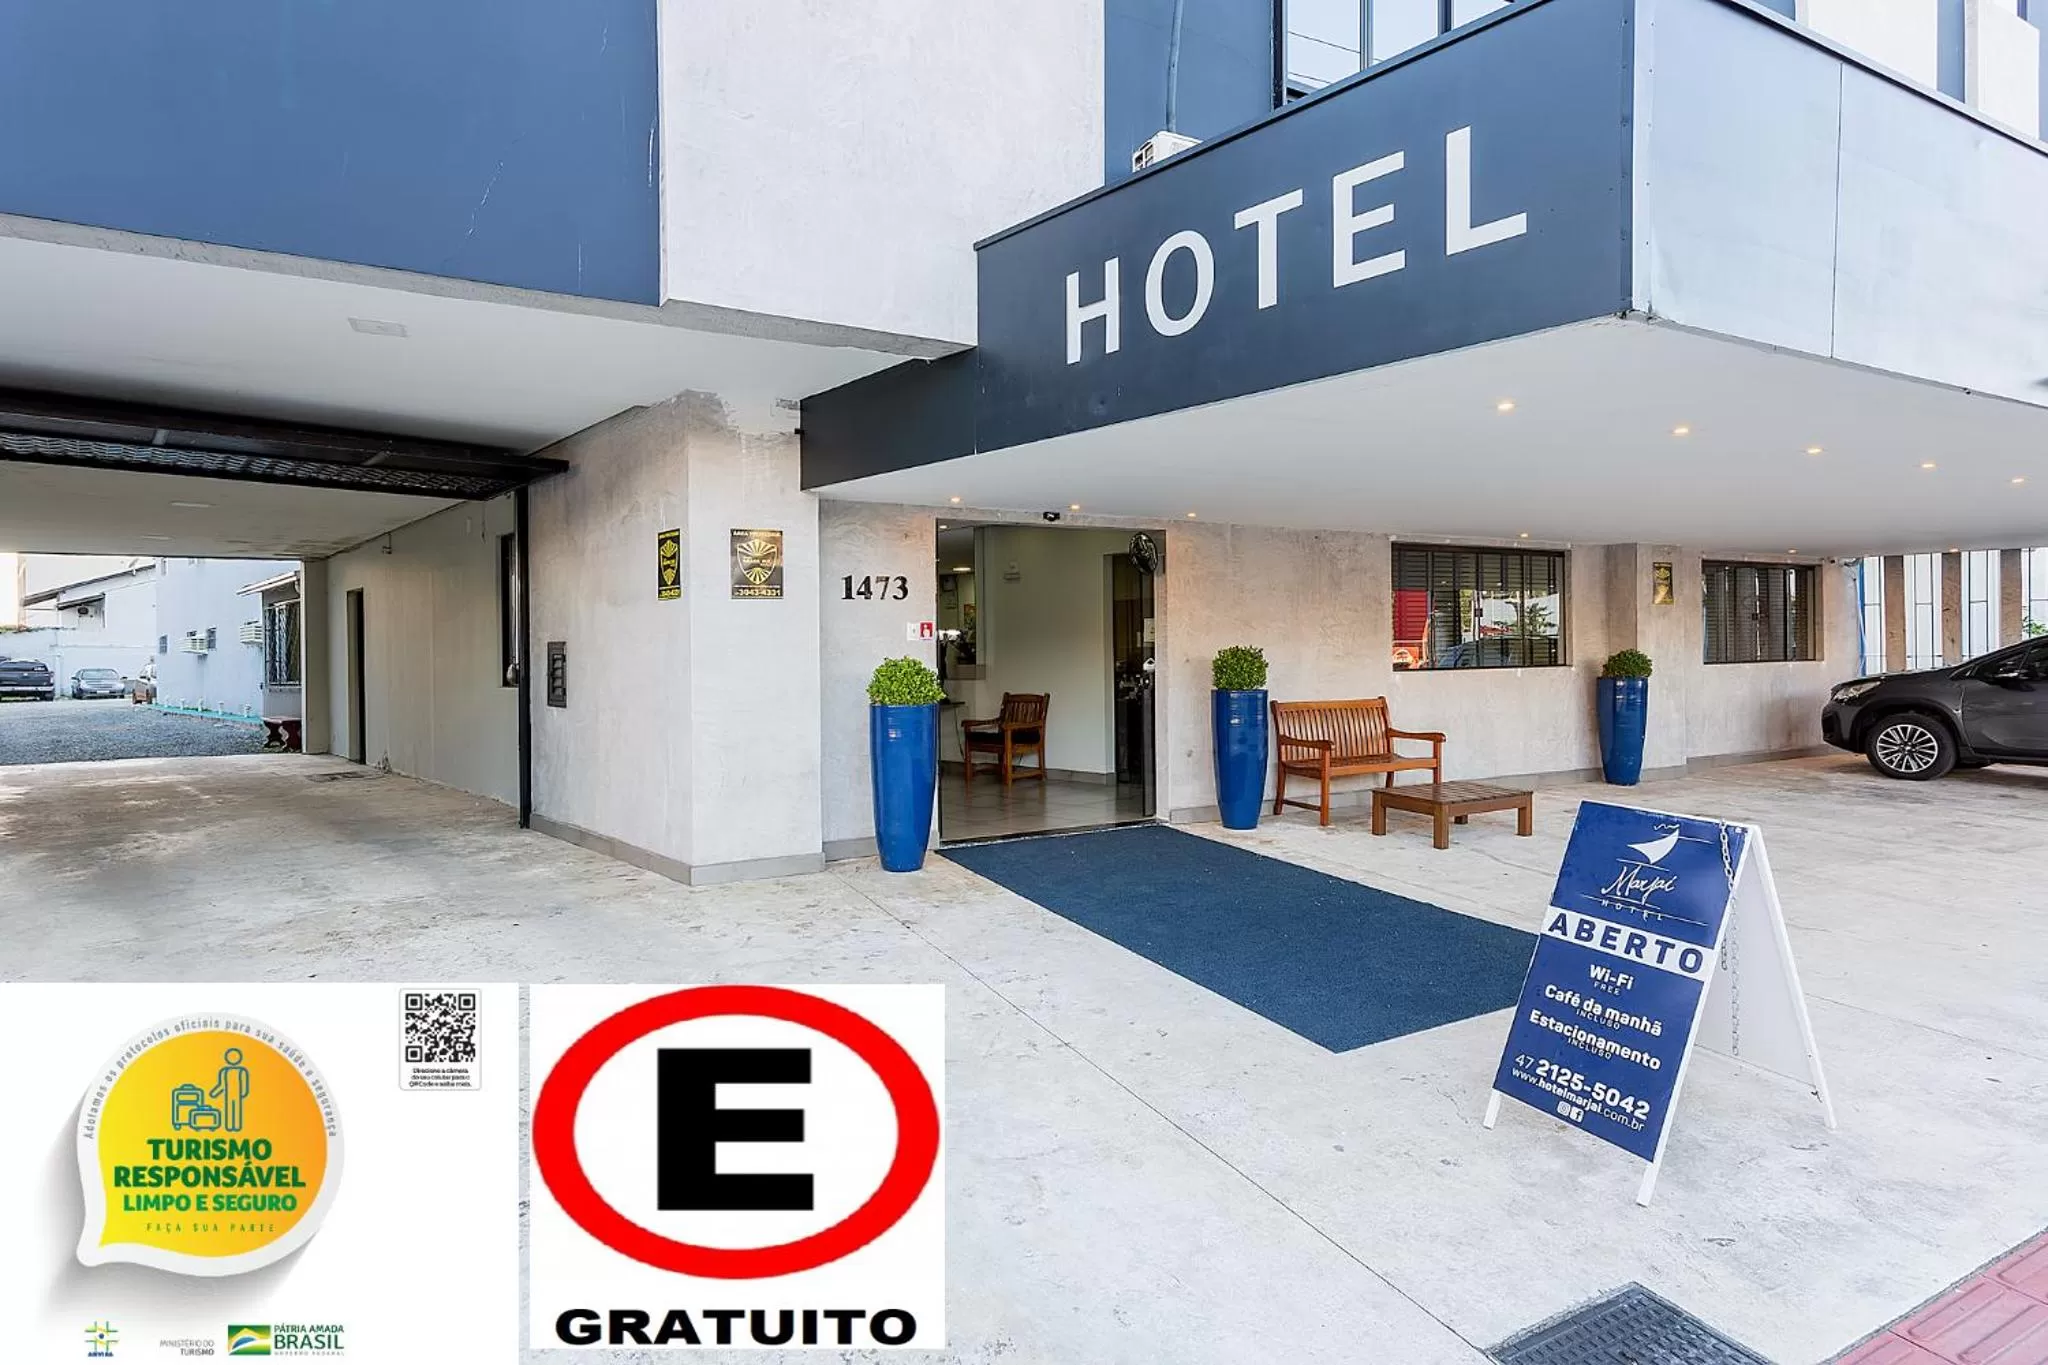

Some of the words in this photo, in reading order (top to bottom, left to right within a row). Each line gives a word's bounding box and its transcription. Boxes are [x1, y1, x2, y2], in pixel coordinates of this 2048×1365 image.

[1066, 125, 1527, 365] HOTEL
[841, 575, 909, 600] 1473
[1601, 900, 1663, 922] HOTEL
[1548, 913, 1703, 974] ABERTO
[1590, 964, 1634, 990] Wi-Fi
[1594, 981, 1621, 996] FREE
[1545, 984, 1581, 1008] Café
[1583, 998, 1602, 1015] da
[1605, 1007, 1663, 1036] manhã
[1576, 1008, 1621, 1030] INCLUSO
[1529, 1009, 1661, 1070] Estacionamento
[1568, 1037, 1612, 1060] INCLUSO
[1512, 1067, 1645, 1131] www.hotelmarjai.com.br
[1515, 1054, 1535, 1069] 47
[1536, 1059, 1650, 1120] 2125-5042
